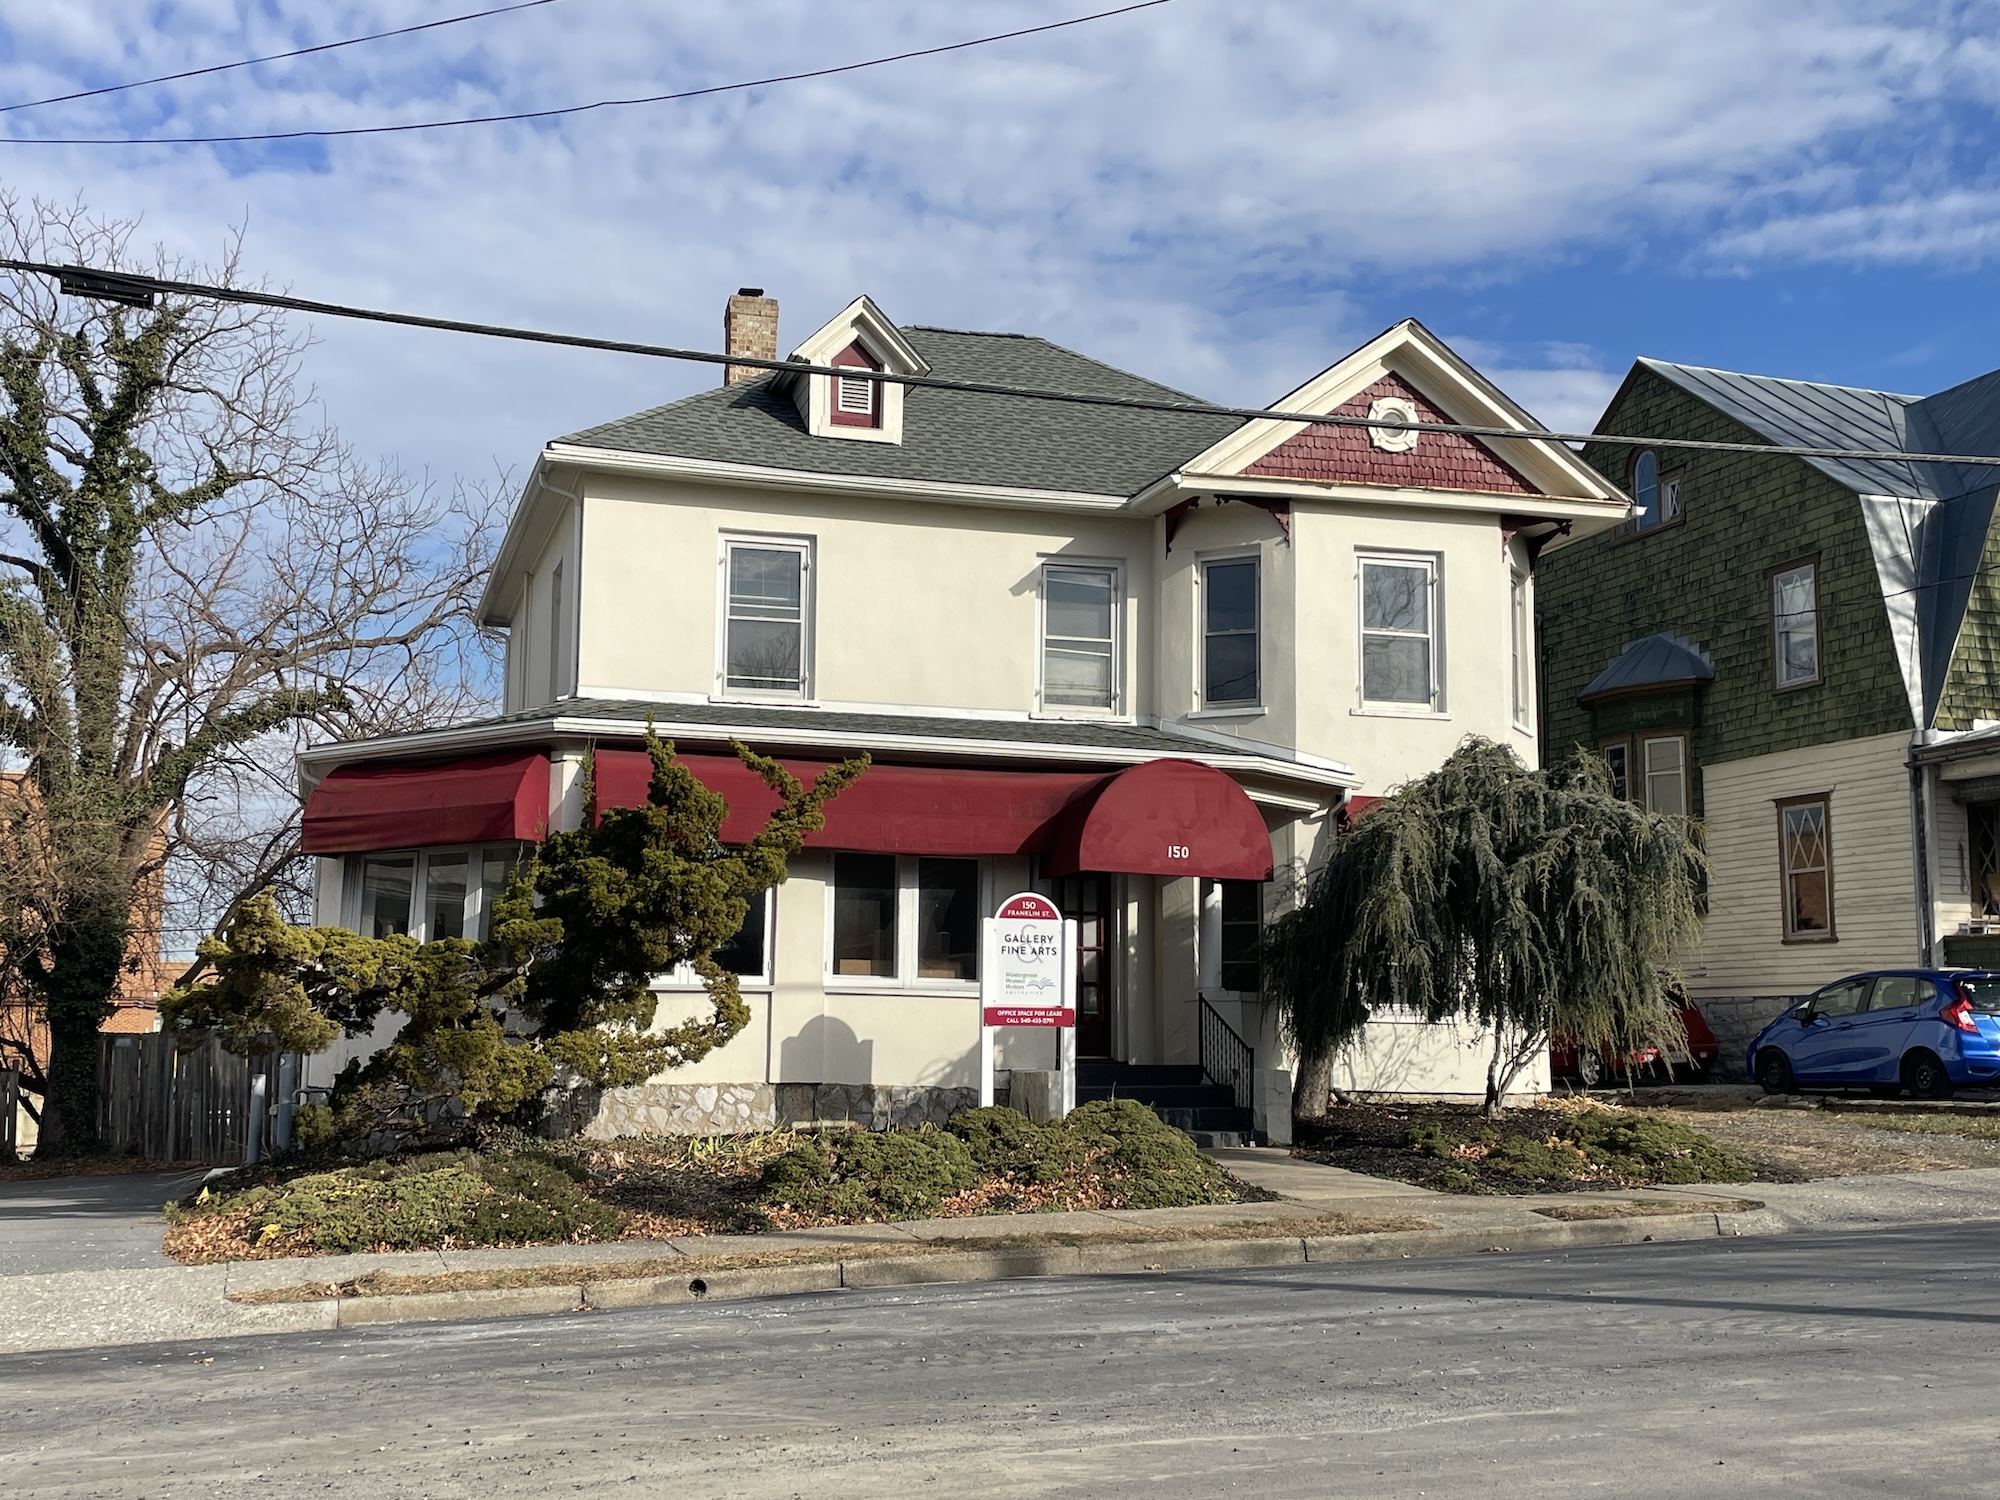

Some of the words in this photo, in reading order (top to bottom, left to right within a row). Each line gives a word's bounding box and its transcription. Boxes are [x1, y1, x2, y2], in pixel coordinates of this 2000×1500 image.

[1168, 845, 1190, 859] 150
[1022, 901, 1036, 909] 150
[1007, 909, 1040, 917] FRANKLIN
[1004, 934, 1054, 944] GALLERY
[1001, 945, 1026, 955] FINE
[1031, 946, 1057, 956] ARTS
